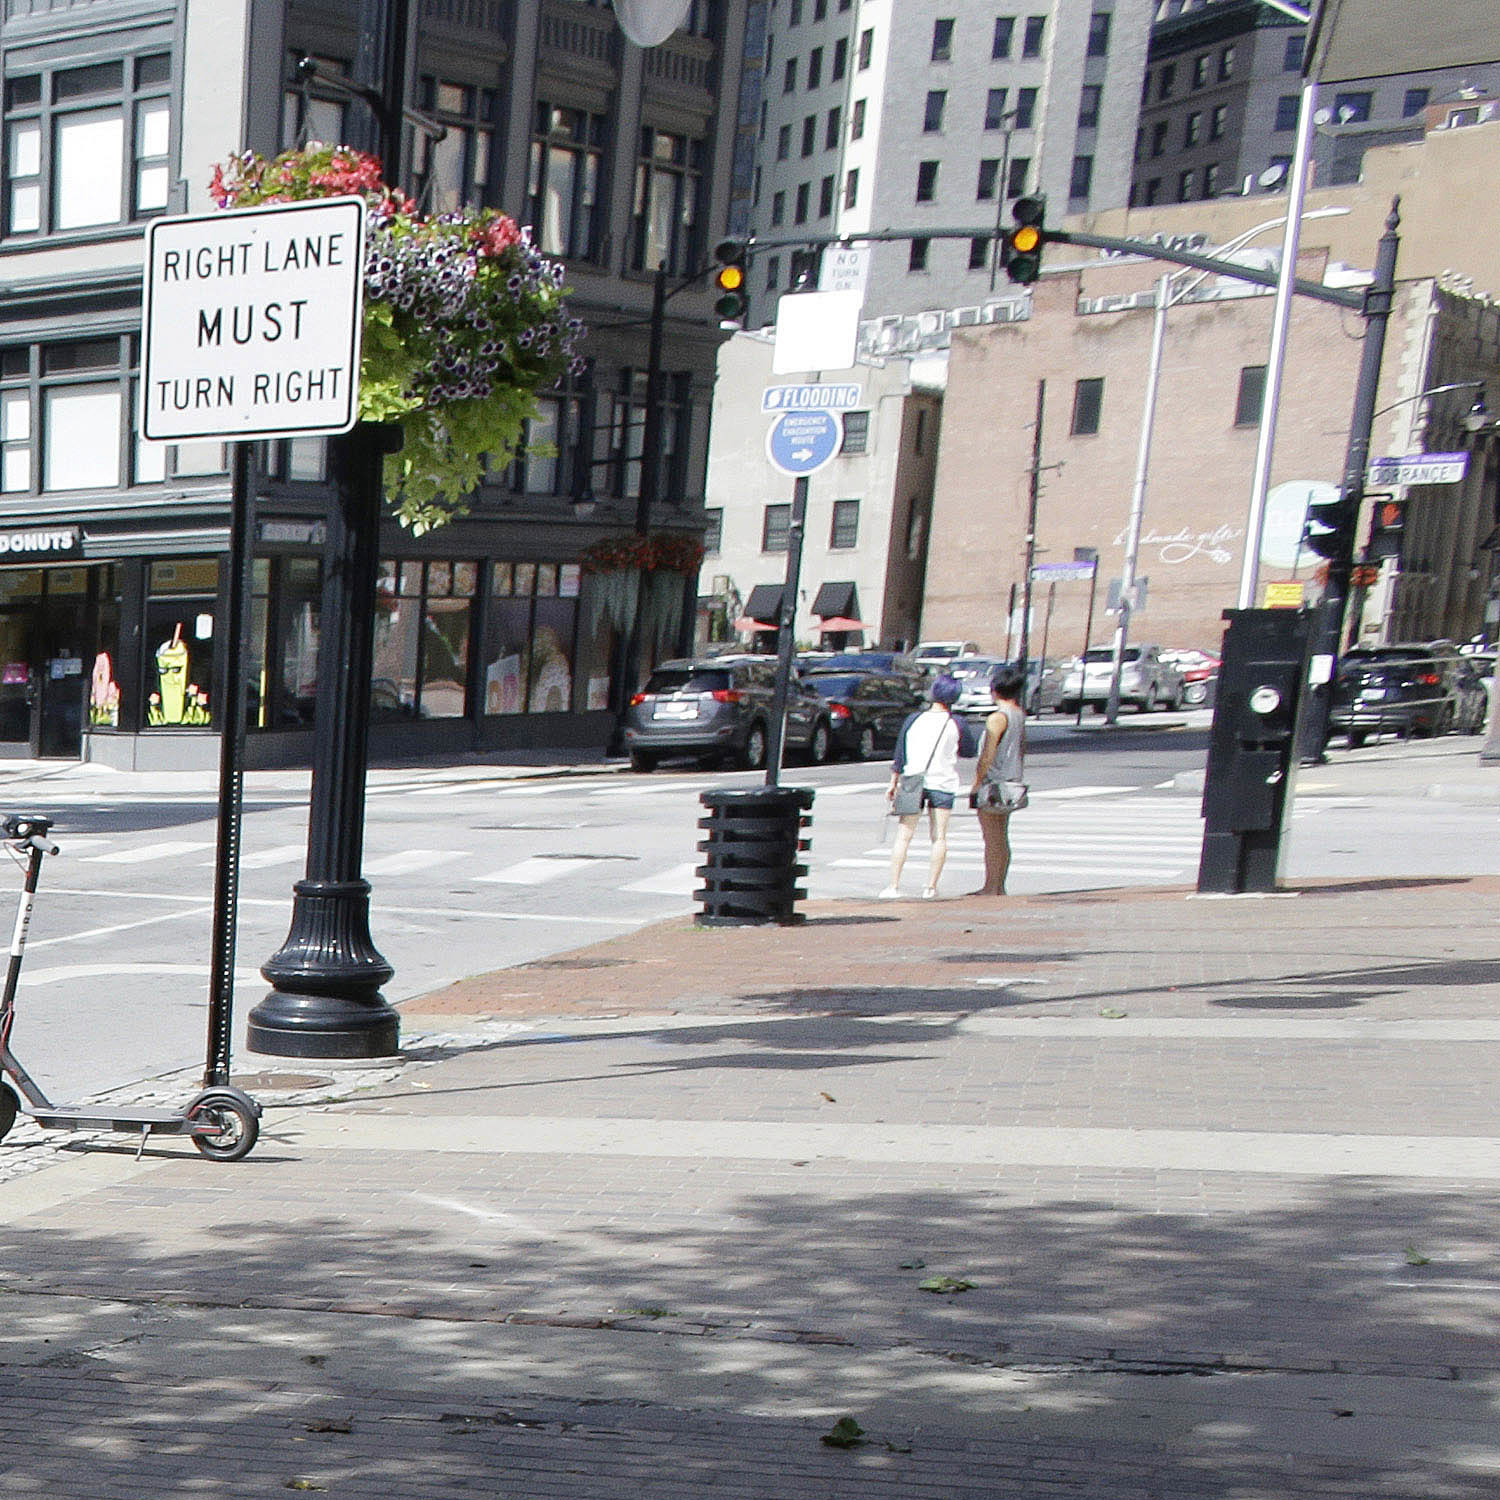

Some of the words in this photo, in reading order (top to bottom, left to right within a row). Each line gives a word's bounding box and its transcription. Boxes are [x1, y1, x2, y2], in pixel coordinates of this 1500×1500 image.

[163, 243, 253, 282] RIGHT
[264, 233, 344, 273] LANE
[836, 252, 859, 265] NO
[831, 268, 860, 278] TURN
[197, 300, 308, 348] MUST
[157, 375, 234, 411] TURN
[254, 368, 343, 405] RIGHT
[783, 387, 857, 408] FLOODING
[1371, 466, 1449, 484] DORRANCE
